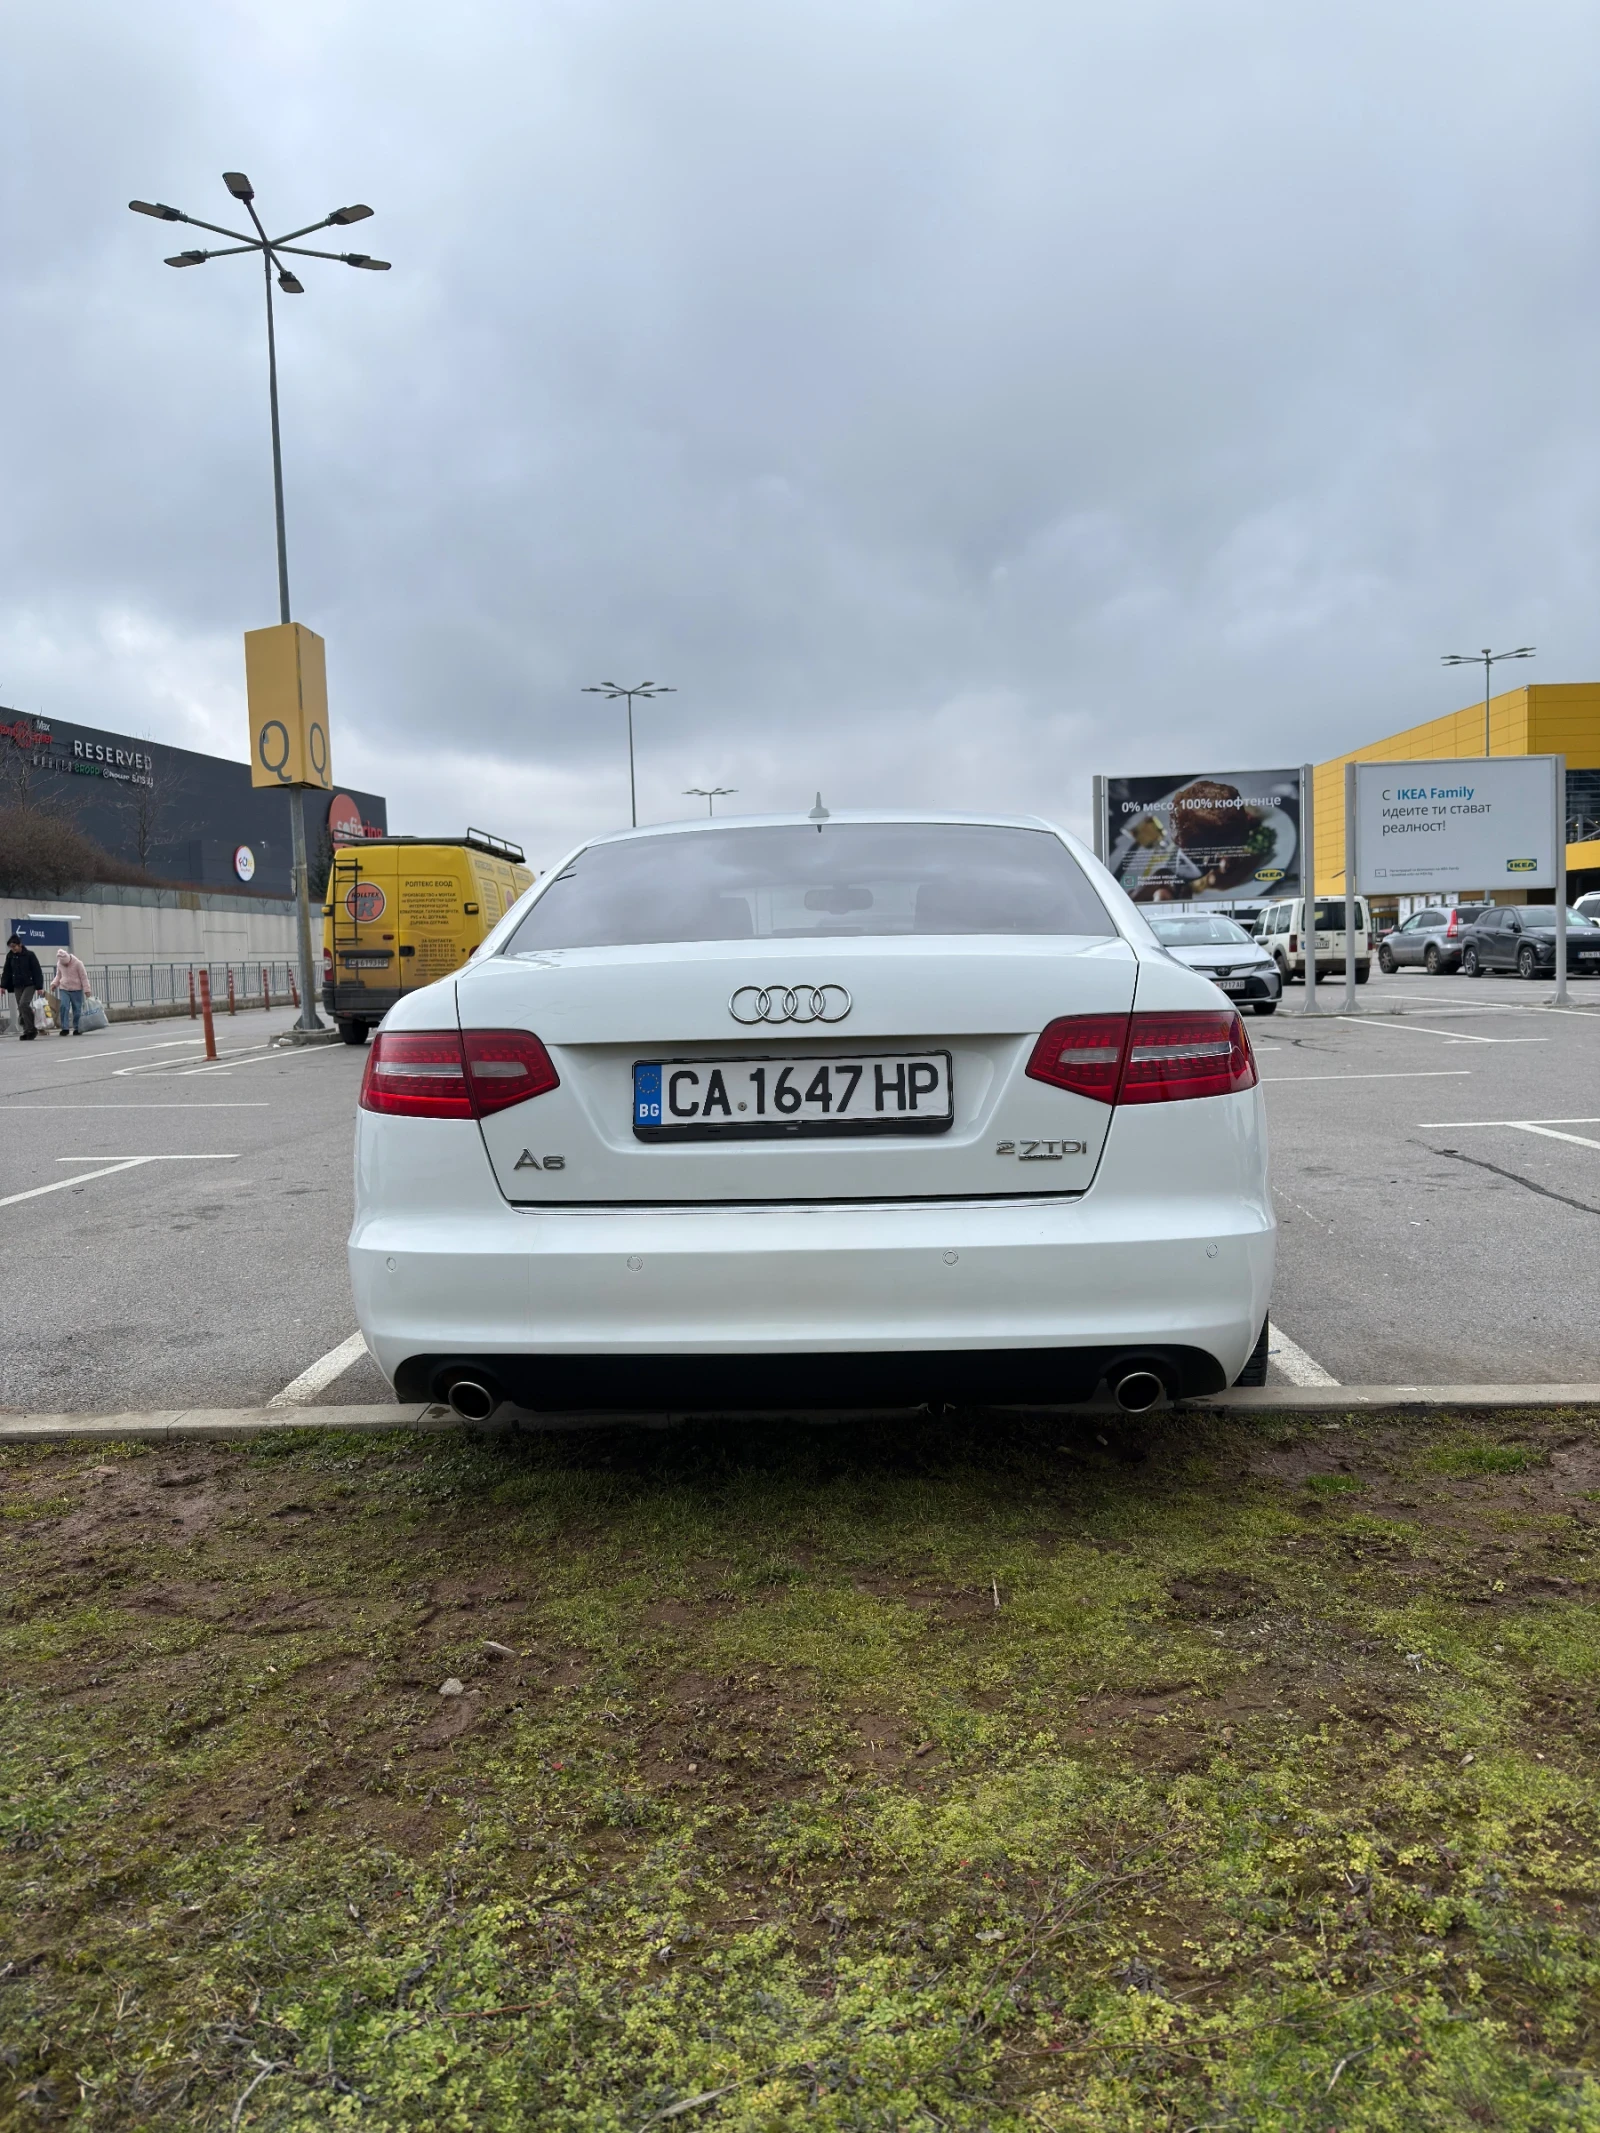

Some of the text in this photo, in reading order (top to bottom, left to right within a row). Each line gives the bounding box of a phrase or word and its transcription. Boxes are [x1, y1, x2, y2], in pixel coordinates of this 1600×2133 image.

[74, 740, 152, 770] RESERVED
[259, 720, 292, 782] Q
[310, 722, 329, 788] Q
[1397, 788, 1427, 800] IKEA
[1430, 786, 1475, 801] Family
[1121, 795, 1282, 813] 0% месо, 100% кюфтенце
[1382, 803, 1492, 818] идеите ти стават
[1382, 820, 1446, 836] реалност!
[1257, 871, 1284, 879] IKEA
[669, 1063, 939, 1117] CA 1647 HP
[639, 1103, 660, 1118] BG
[513, 1147, 566, 1171] A6
